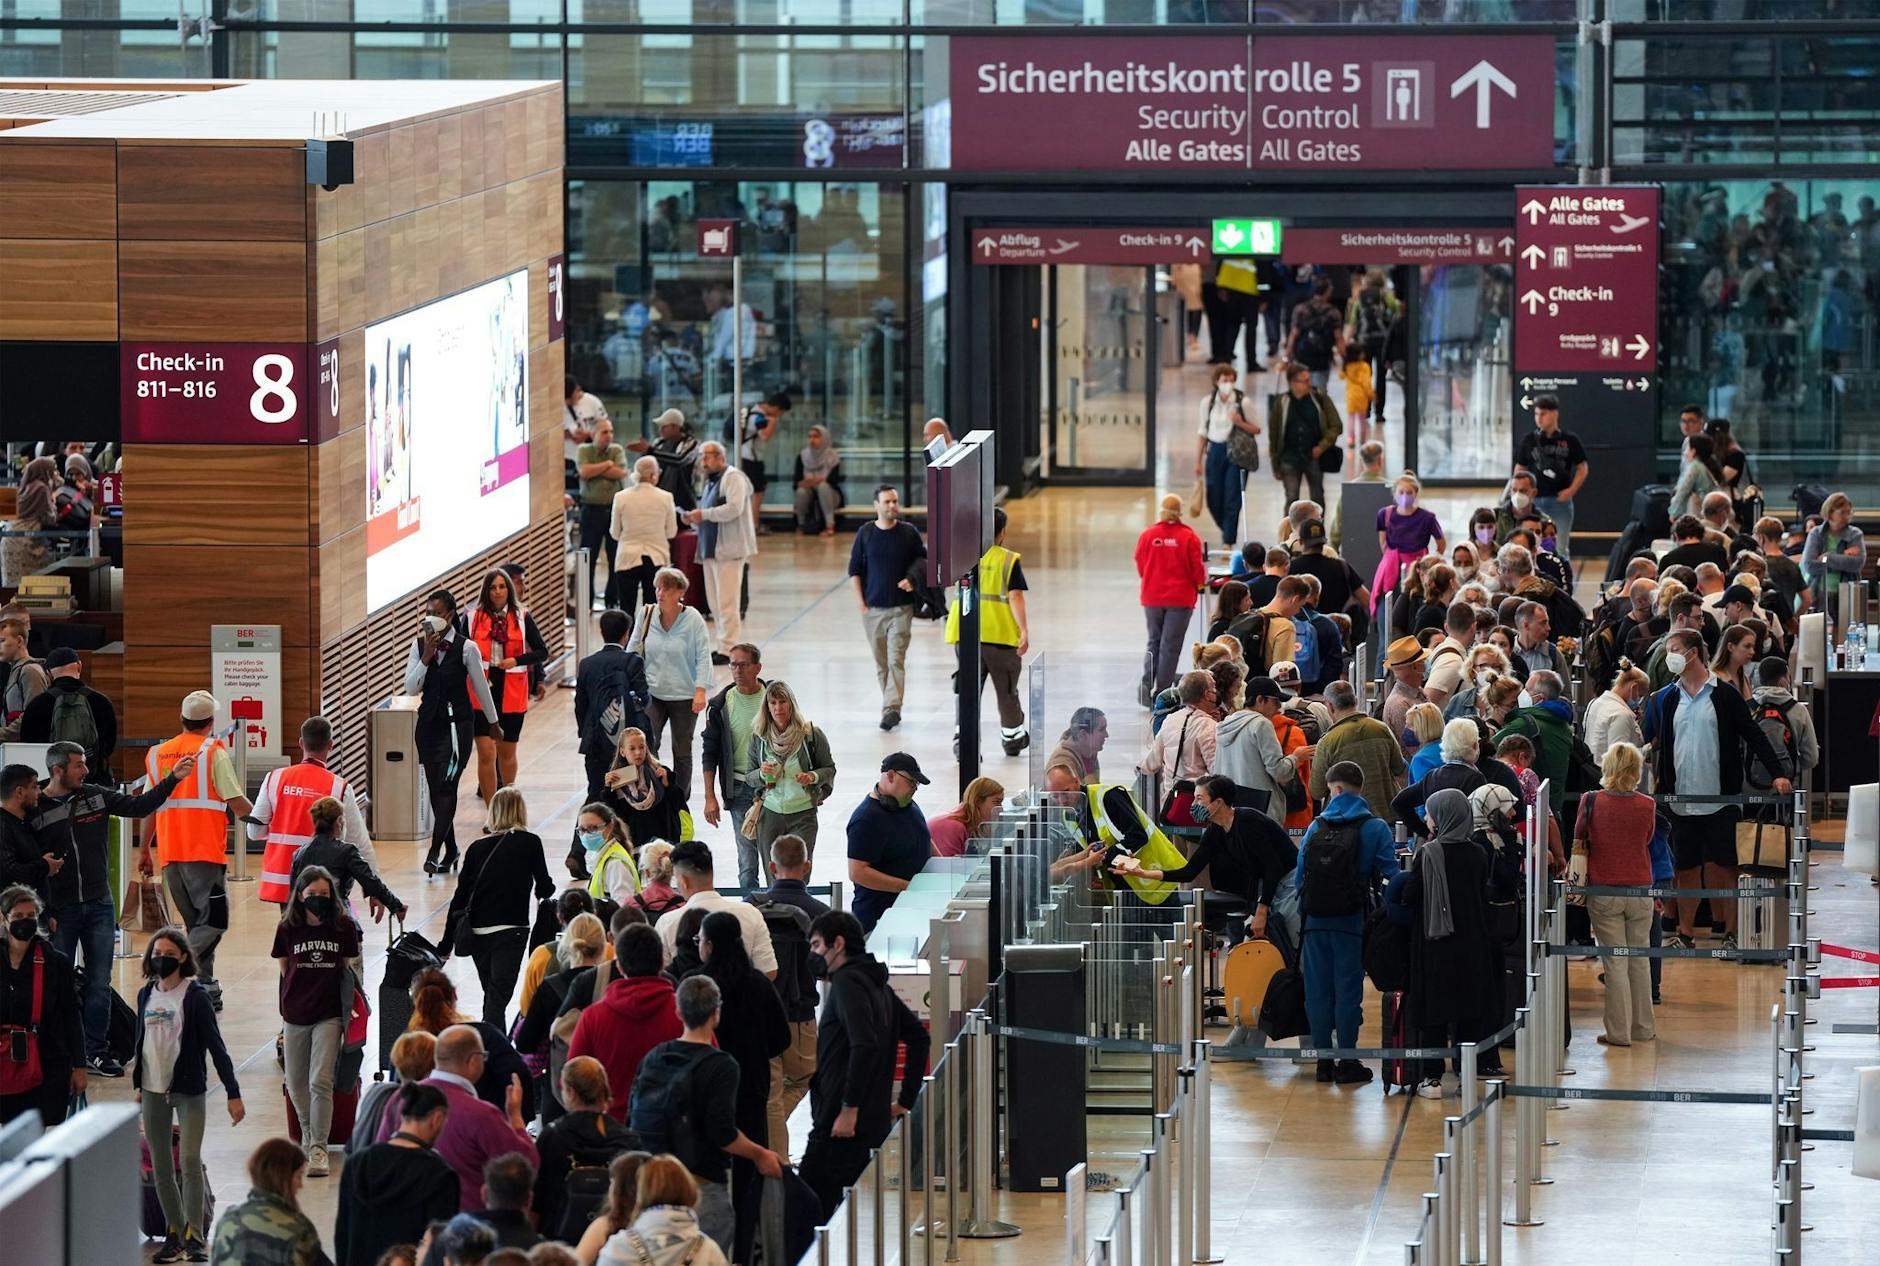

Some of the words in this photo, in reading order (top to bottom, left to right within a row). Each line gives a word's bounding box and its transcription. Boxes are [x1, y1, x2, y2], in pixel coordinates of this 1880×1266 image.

[977, 61, 1333, 94] Sicherheitskontrolle
[1342, 62, 1361, 93] 5
[1138, 103, 1247, 136] Security
[1262, 103, 1360, 130] Control
[1125, 138, 1172, 162] Alle
[1178, 138, 1246, 162] Gates
[1259, 138, 1290, 162] All
[1297, 138, 1361, 162] Gates
[1549, 196, 1580, 211] Alle
[1582, 196, 1625, 211] Gates
[1549, 212, 1565, 225] All
[1566, 212, 1600, 225] Gates
[999, 233, 1041, 249] Abflug
[1119, 233, 1172, 246] Check-in
[1174, 234, 1183, 246] 9
[1341, 233, 1461, 246] Sicherheitskontrolle
[1464, 233, 1472, 246] 5
[999, 248, 1046, 258] Departure
[1397, 247, 1436, 258] Security
[1437, 247, 1471, 257] Control
[555, 263, 564, 322] 8
[1548, 286, 1614, 301] Check-in
[1548, 302, 1560, 317] 9
[136, 352, 224, 371] Check-in
[330, 348, 339, 417] 8
[249, 353, 298, 424] 8
[237, 629, 255, 638] BER
[283, 784, 304, 797] BER
[1748, 795, 1763, 804] BER
[1288, 828, 1303, 837] BER
[1647, 888, 1663, 897] BER
[1739, 889, 1755, 897] BER
[293, 940, 340, 955] HARVARD
[1613, 947, 1630, 956] BER
[1711, 949, 1728, 958] BER
[1850, 950, 1867, 961] STOP
[1000, 1026, 1013, 1036] BER
[1075, 1035, 1088, 1045] BER
[1152, 1043, 1165, 1053] BER
[1300, 1049, 1318, 1058] BER
[1405, 1048, 1422, 1058] BER
[1564, 1089, 1582, 1099] BER
[1673, 1092, 1691, 1102] BER
